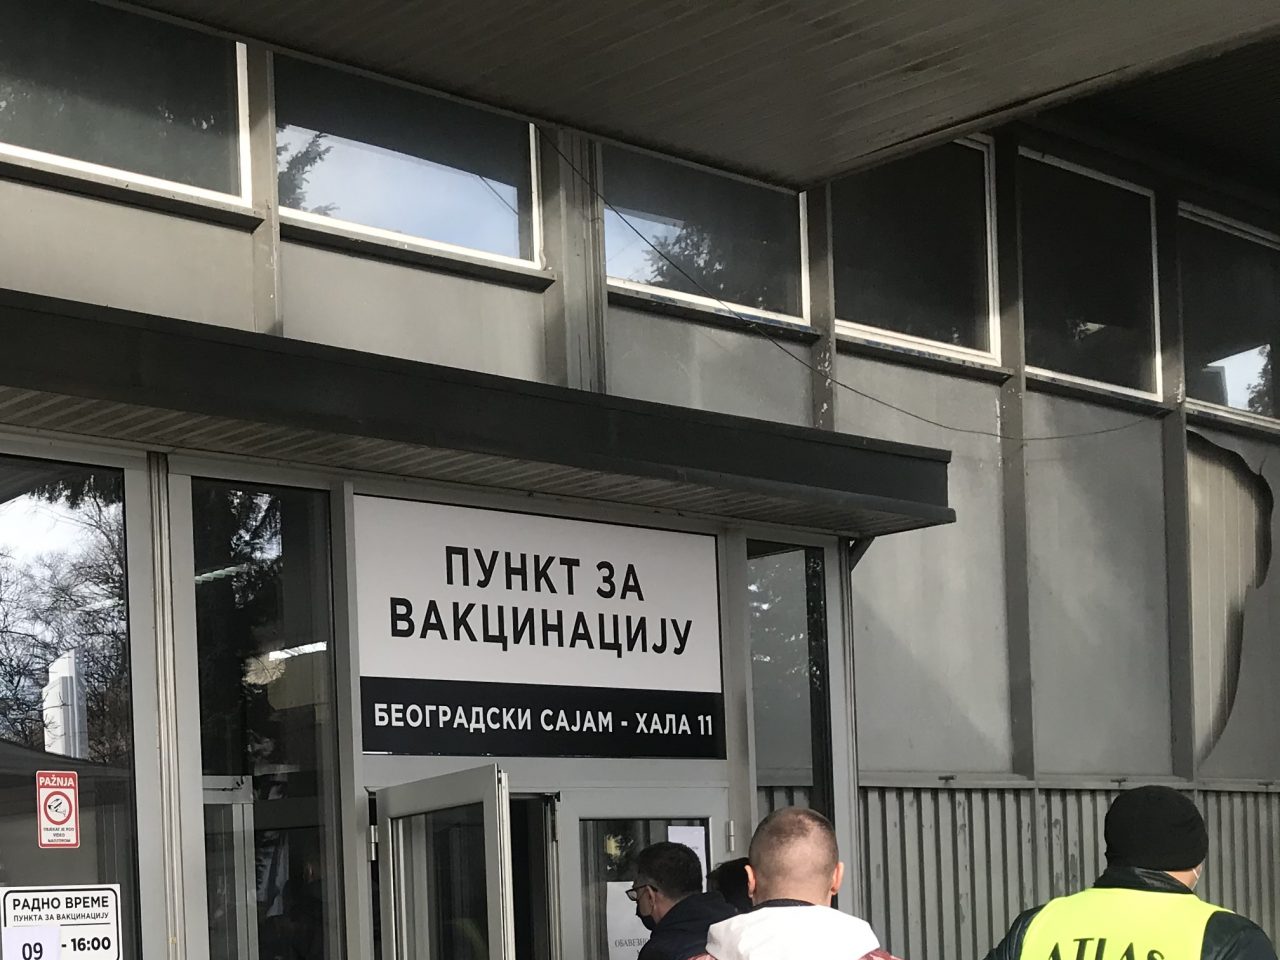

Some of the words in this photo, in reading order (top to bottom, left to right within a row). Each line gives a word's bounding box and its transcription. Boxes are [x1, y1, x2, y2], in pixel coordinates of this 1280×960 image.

[445, 545, 581, 596] ПУНКТ
[596, 560, 645, 602] ЗА
[389, 596, 693, 659] ВАКЦИНАЦИЈУ
[374, 702, 532, 735] БЕОГРАДСКИ
[540, 708, 614, 734] САЈАМ
[635, 711, 693, 736] ХАЛА
[697, 714, 714, 736] 11
[39, 774, 75, 787] PAŽNJA
[12, 896, 61, 912] РАДНО
[65, 895, 110, 909] ВРЕМЕ
[13, 914, 43, 922] ПУНКТА
[45, 913, 55, 921] ЗА
[56, 911, 109, 921] ВАКЦИНАЦИЈУ
[70, 936, 112, 952] 16:00
